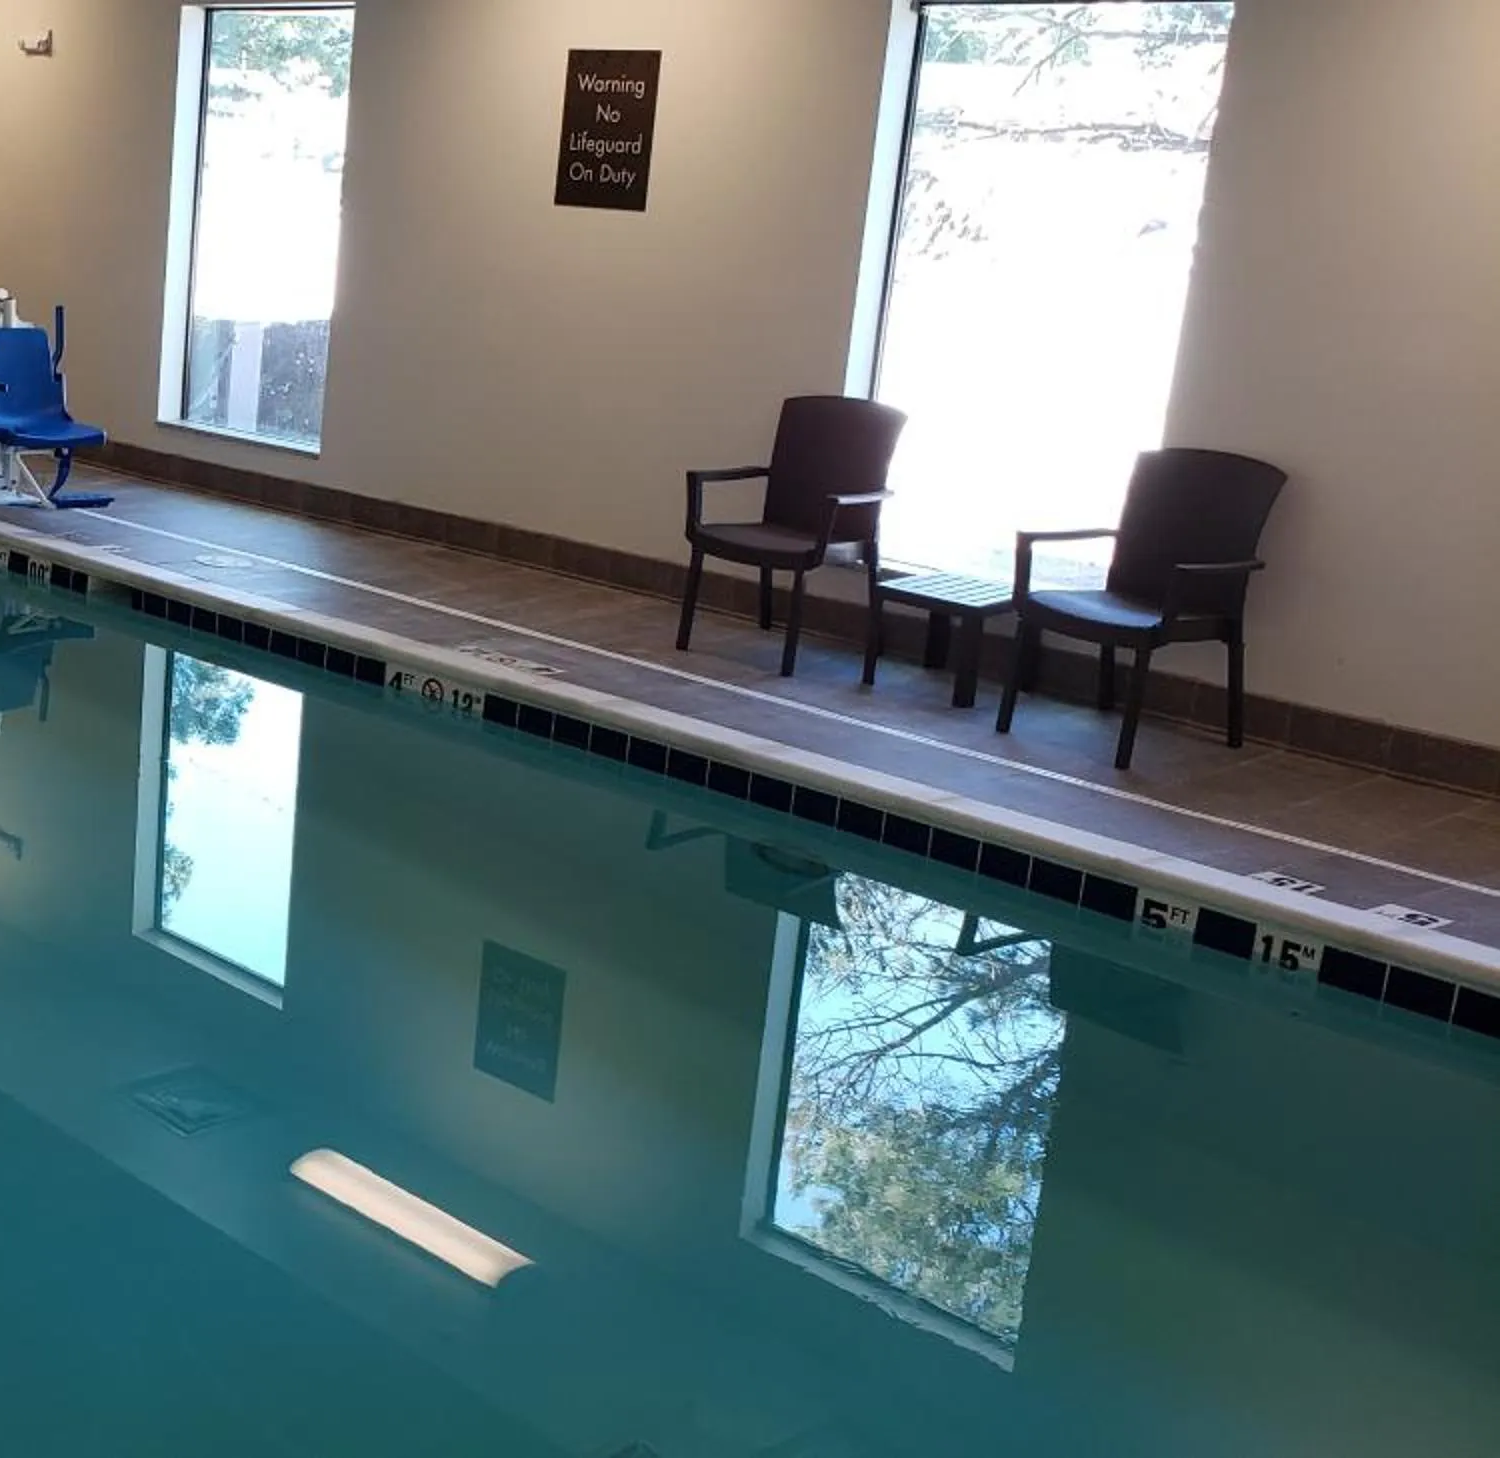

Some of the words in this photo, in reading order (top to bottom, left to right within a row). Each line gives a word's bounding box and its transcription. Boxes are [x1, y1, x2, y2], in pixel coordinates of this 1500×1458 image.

[577, 72, 645, 99] Warning
[595, 103, 621, 123] No
[569, 131, 643, 158] Lifeguard
[569, 161, 593, 182] On
[599, 163, 636, 189] Duty
